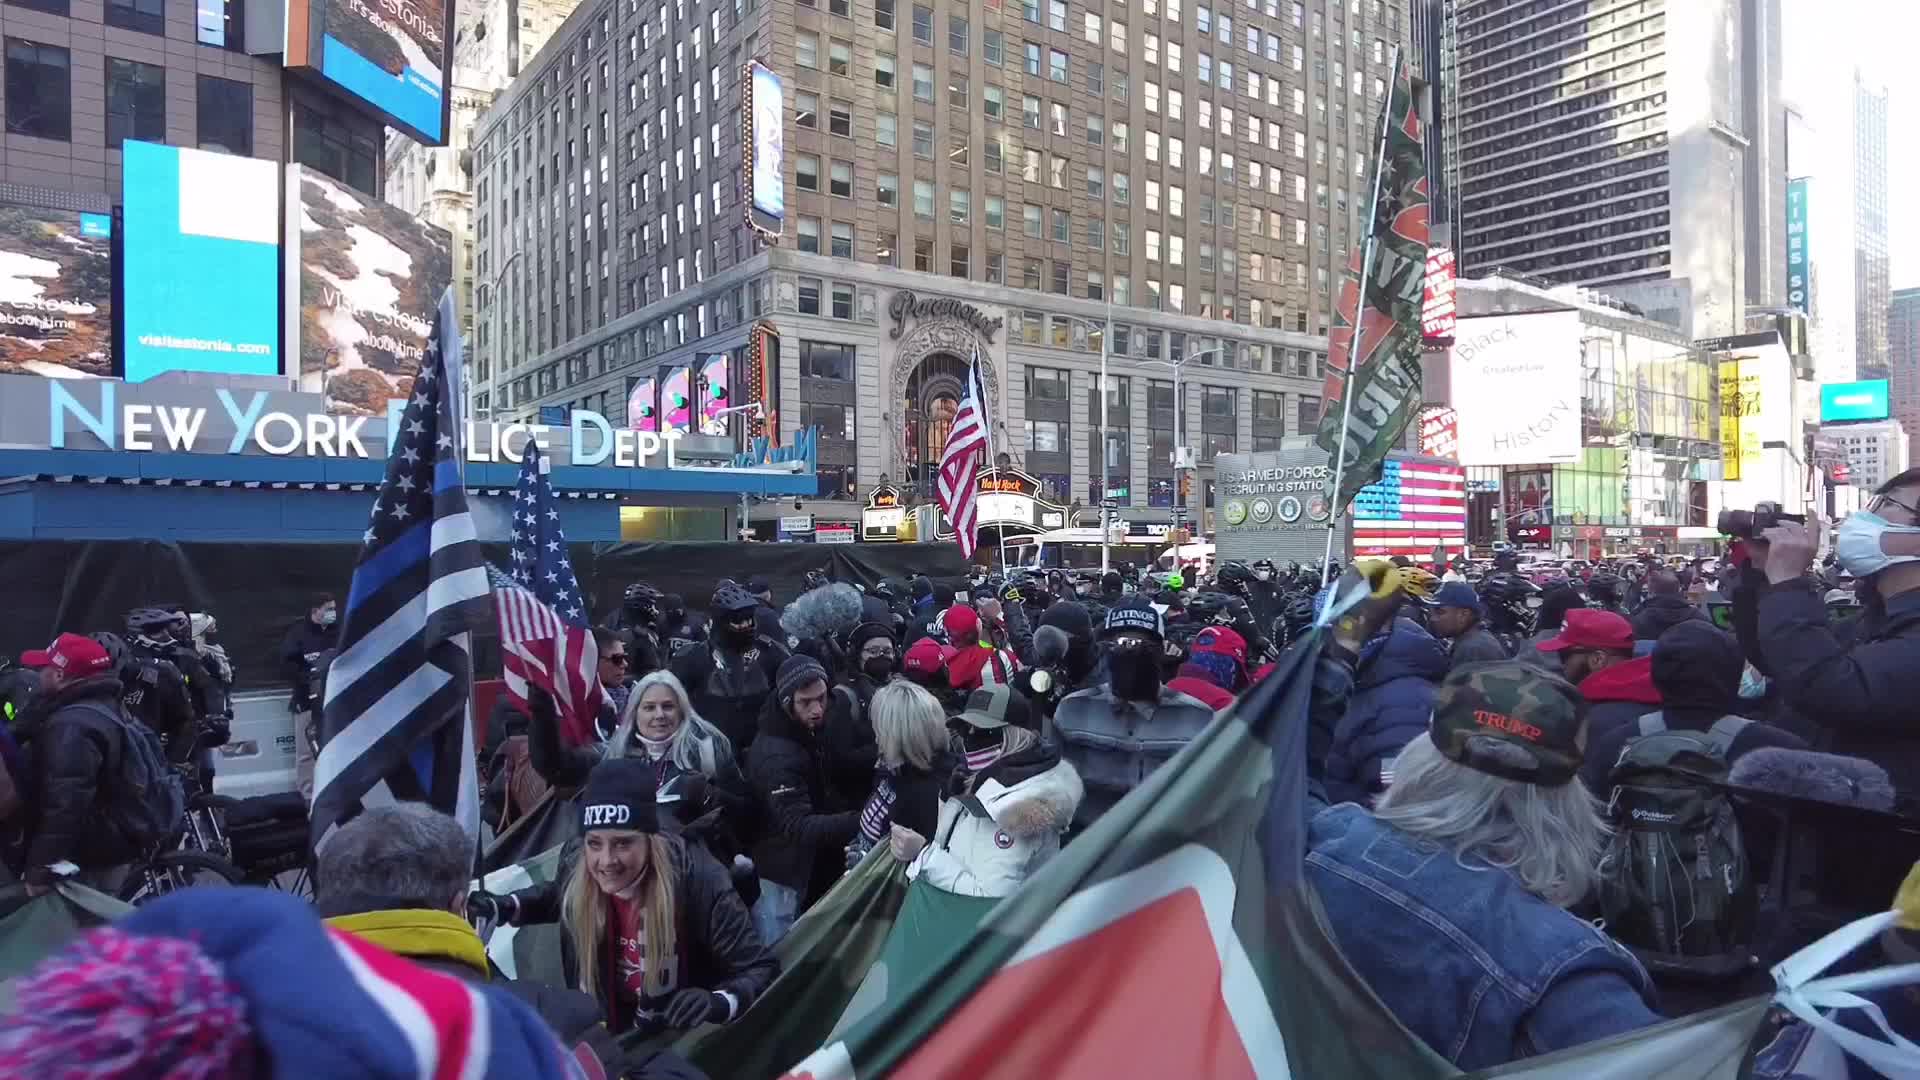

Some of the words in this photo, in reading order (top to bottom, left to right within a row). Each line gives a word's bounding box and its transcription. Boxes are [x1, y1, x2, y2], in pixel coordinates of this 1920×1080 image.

[1789, 191, 1803, 265] TIMES
[137, 335, 271, 355] visitestonia.com
[1455, 319, 1519, 362] Black
[216, 388, 369, 458] YORK
[570, 408, 682, 469] DEPT
[1493, 399, 1571, 452] History
[1239, 467, 1284, 482] ARMED
[1286, 464, 1329, 480] FORCE
[981, 478, 1000, 490] Hard
[1002, 479, 1023, 492] Rock
[1223, 482, 1284, 496] RECRUITING
[1285, 479, 1325, 492] STATIO
[1111, 609, 1156, 624] LATINOS
[1473, 709, 1543, 742] TRUMP
[584, 804, 630, 826] NYPD
